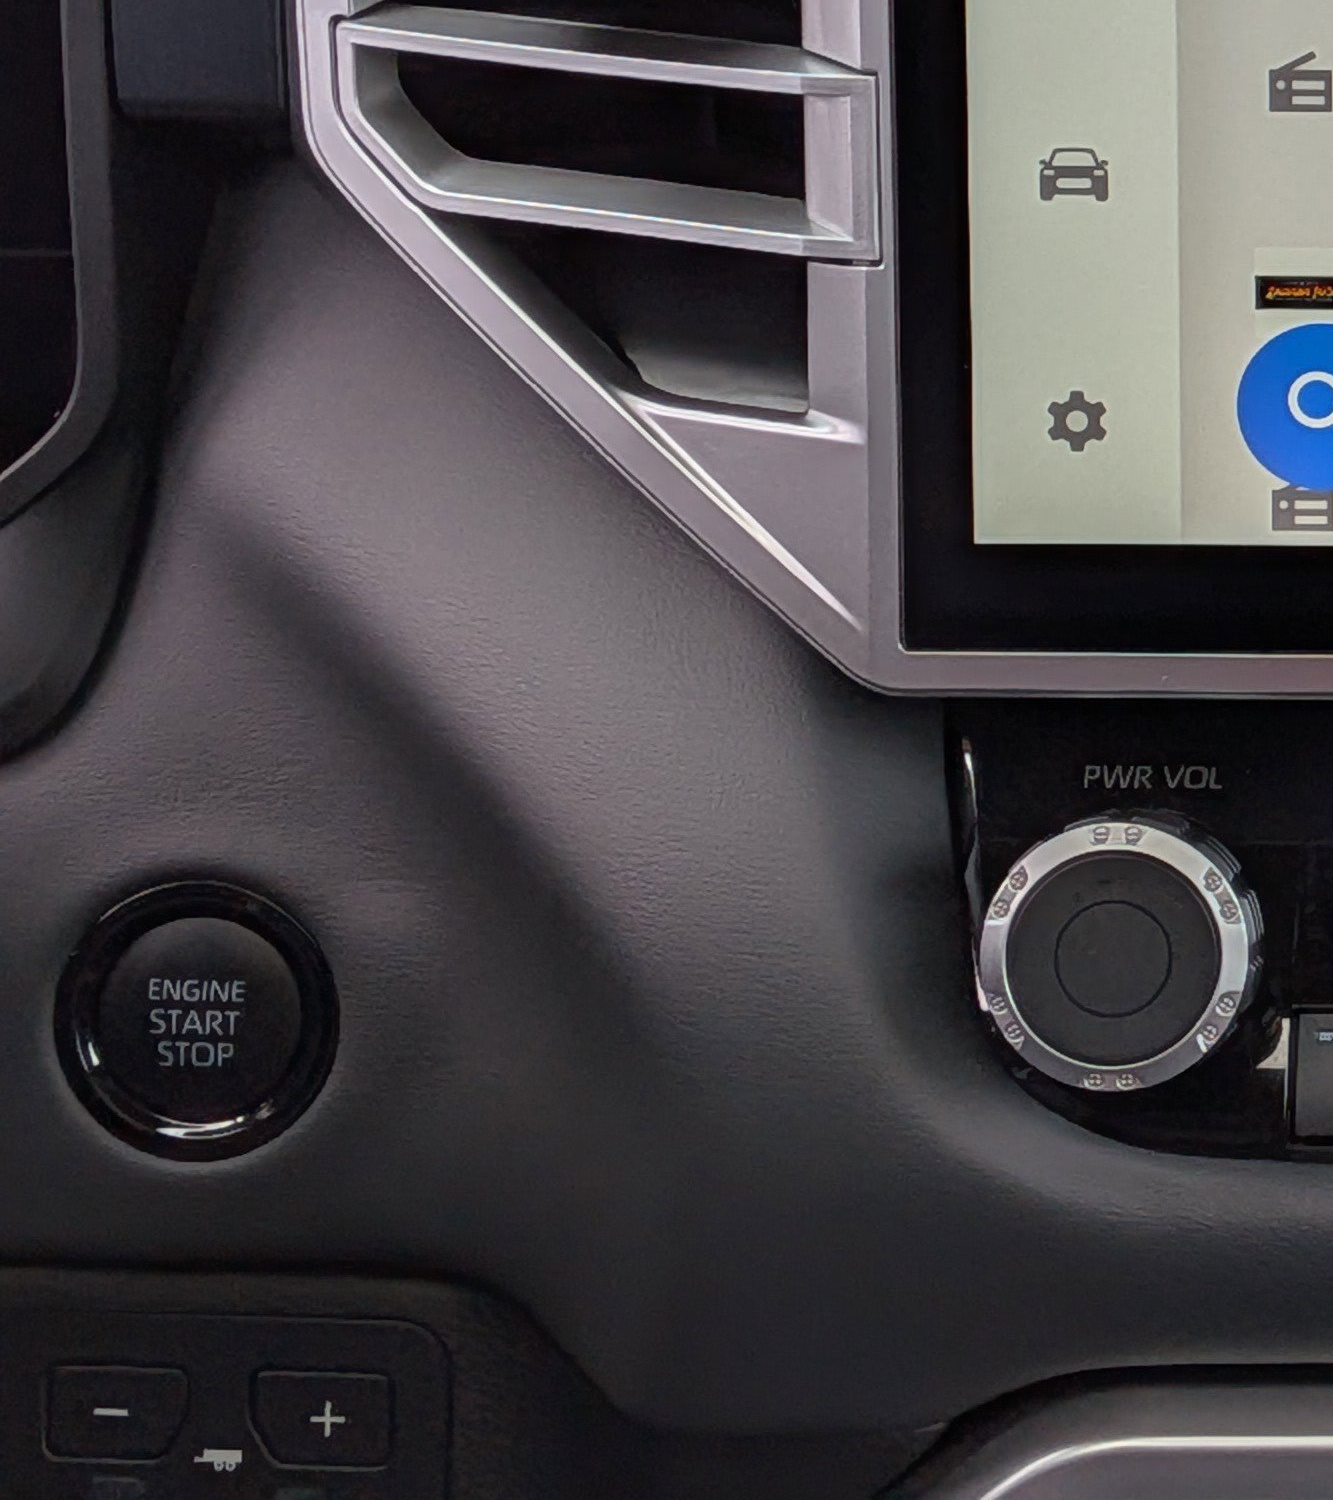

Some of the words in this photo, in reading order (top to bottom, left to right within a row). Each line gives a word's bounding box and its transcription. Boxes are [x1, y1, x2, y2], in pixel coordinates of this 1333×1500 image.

[1082, 764, 1154, 791] PWR
[1162, 765, 1224, 793] VOL
[148, 978, 247, 1003] ENGINE
[148, 1009, 241, 1037] START
[156, 1041, 235, 1068] STOP
